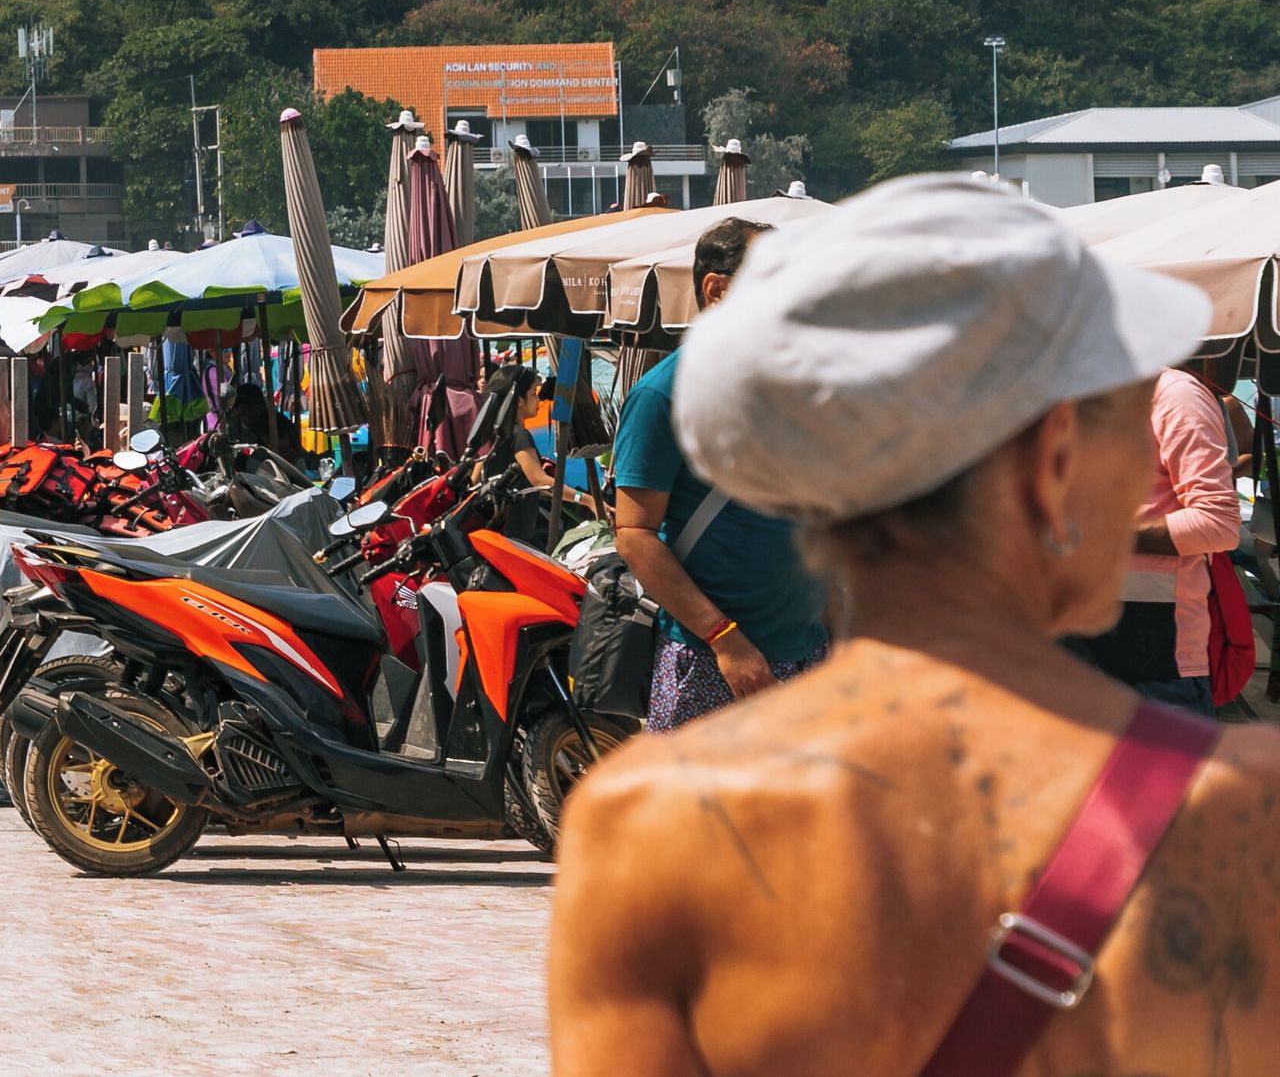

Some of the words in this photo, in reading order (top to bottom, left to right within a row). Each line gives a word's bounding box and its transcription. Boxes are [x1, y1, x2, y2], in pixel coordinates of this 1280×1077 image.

[446, 63, 466, 73] KOH
[468, 63, 487, 72] LAN
[488, 62, 533, 72] SECURITY
[530, 78, 580, 87] COMMAND
[582, 77, 619, 87] CENTER
